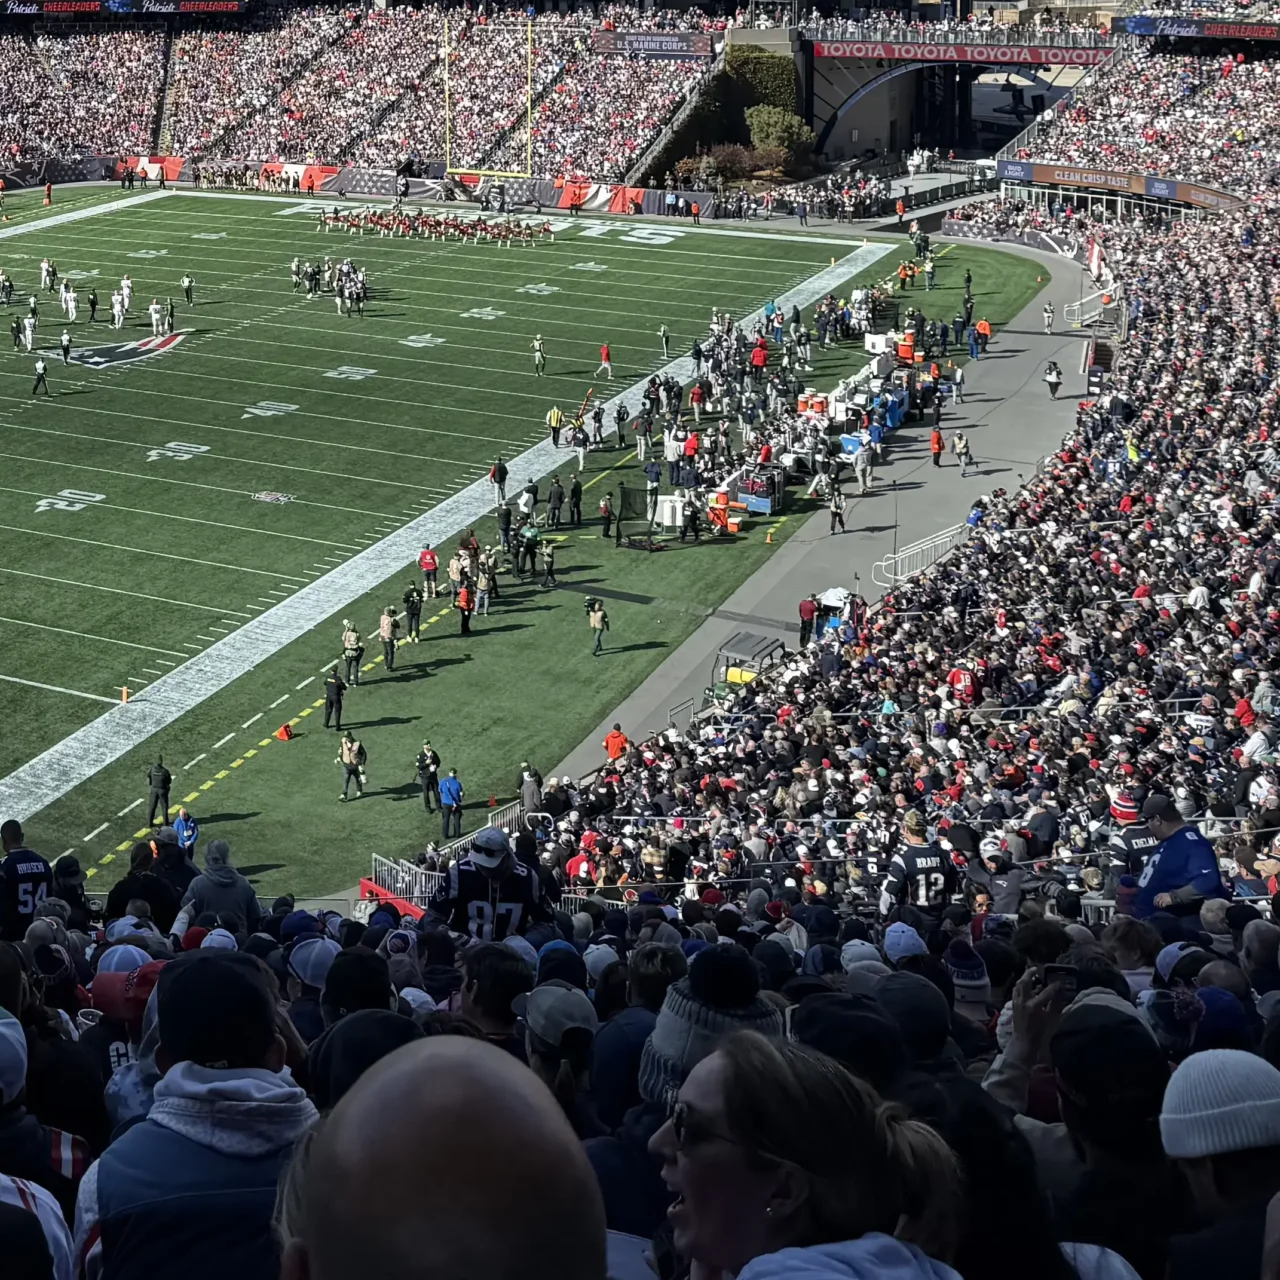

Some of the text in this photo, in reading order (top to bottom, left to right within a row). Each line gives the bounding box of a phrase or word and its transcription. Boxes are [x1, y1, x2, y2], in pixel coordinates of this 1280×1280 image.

[6, 0, 101, 15] Patriots CHEERLEADERS
[179, 0, 239, 12] CHEERLEADERS
[1156, 19, 1279, 38] Patriots CHEERLEADERS
[633, 41, 660, 50] MARINE
[662, 42, 688, 51] CORPS
[821, 43, 885, 58] TOYOTA
[892, 44, 958, 59] TOYOTA
[964, 46, 1030, 61] TOYOTA
[1039, 47, 1106, 62] TOYOTA
[1005, 170, 1024, 178] LIGHT
[1055, 171, 1129, 188] CLEAN CRISP TASTE
[1152, 187, 1169, 195] LIGHT
[322, 365, 378, 380] 50
[244, 400, 300, 417] 40
[147, 441, 211, 461] 30
[36, 488, 106, 512] 20
[915, 856, 941, 869] BRADY
[916, 872, 945, 907] 12
[18, 882, 48, 914] 54
[467, 900, 524, 941] 87
